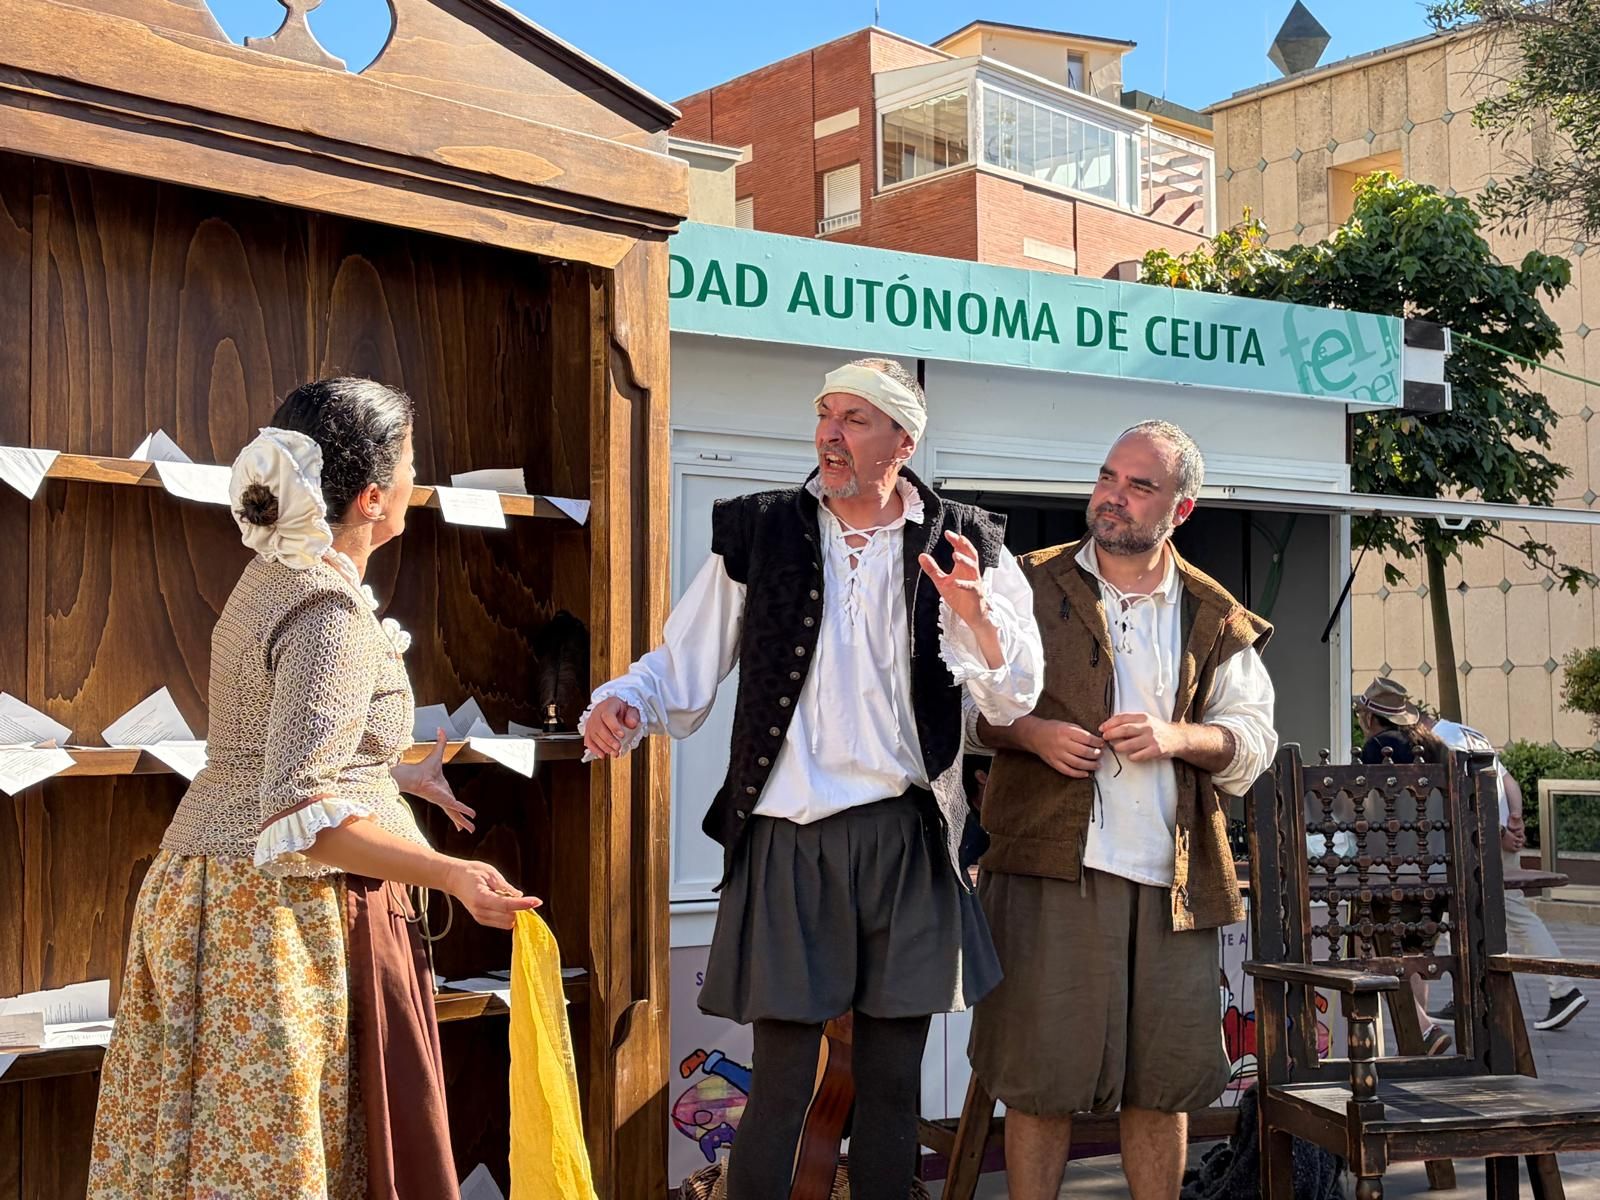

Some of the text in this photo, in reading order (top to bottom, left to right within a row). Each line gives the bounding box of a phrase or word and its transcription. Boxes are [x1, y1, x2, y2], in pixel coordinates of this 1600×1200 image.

[787, 273, 1060, 344] AUTÓNOMA
[1076, 306, 1129, 352] DE
[1145, 315, 1266, 367] CEUTA
